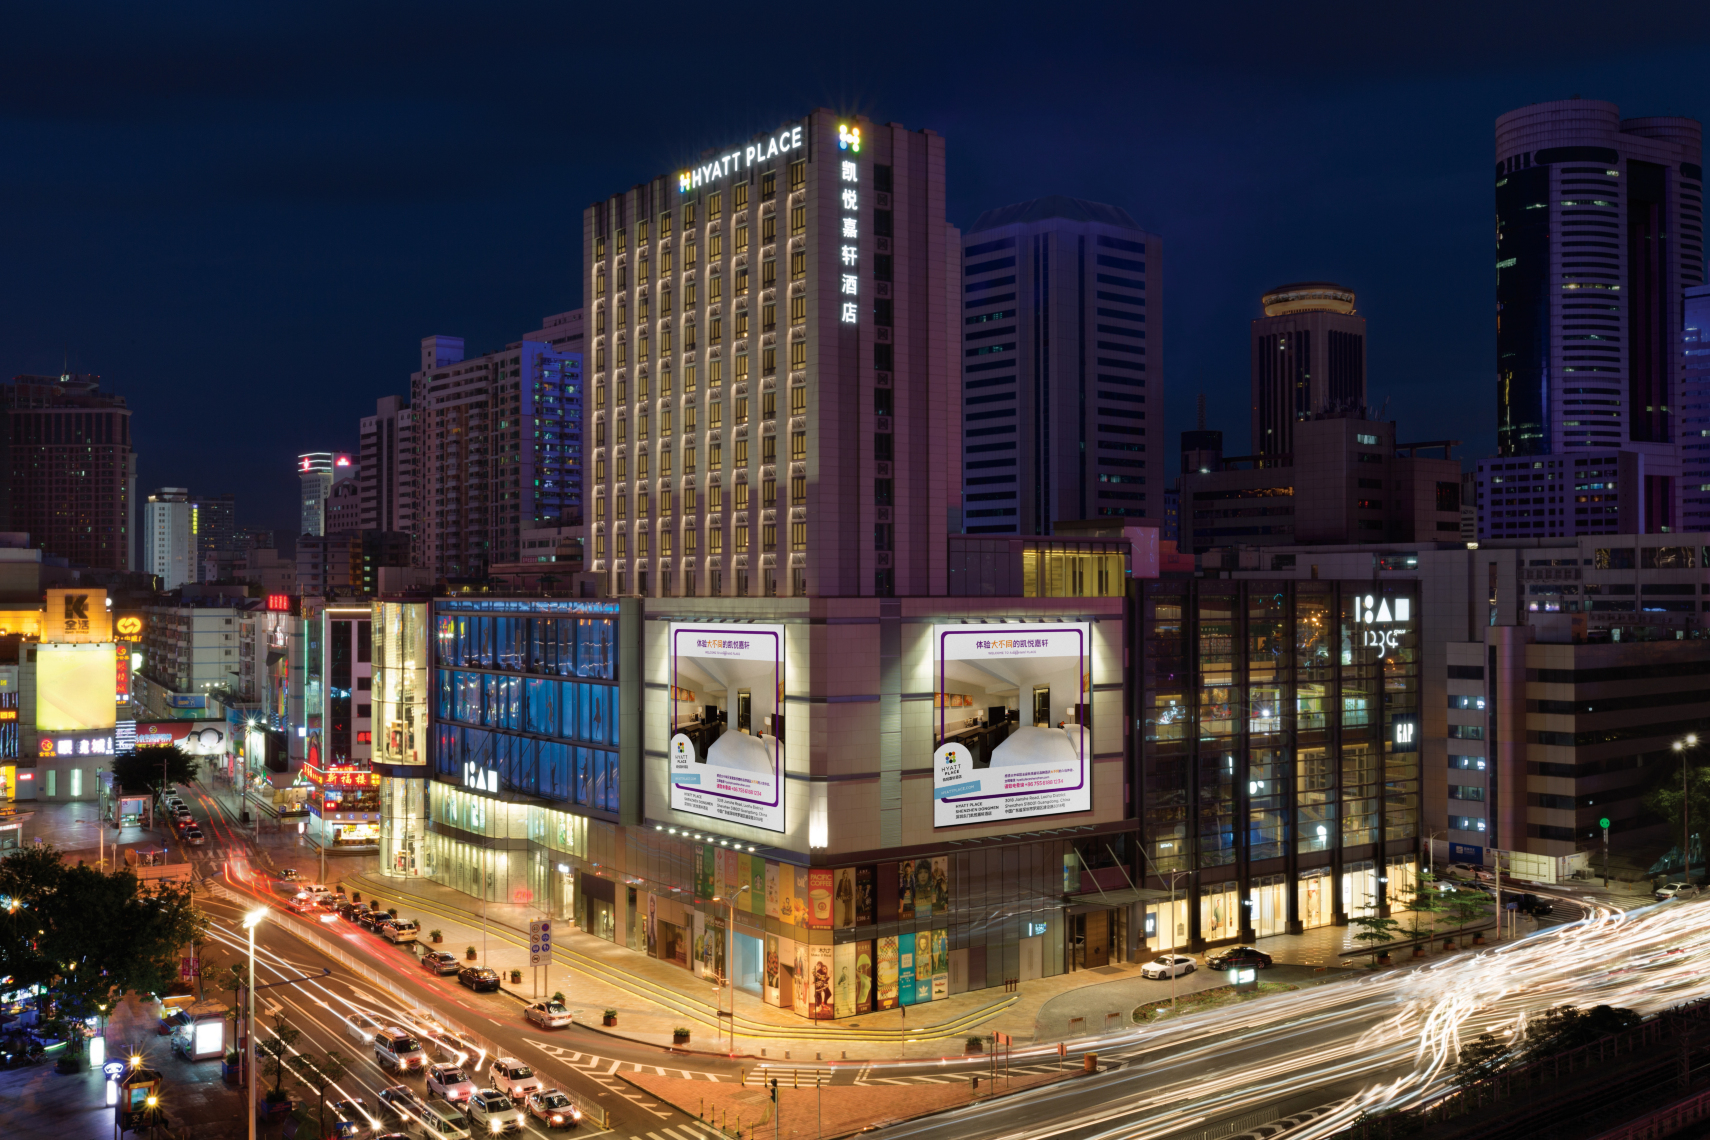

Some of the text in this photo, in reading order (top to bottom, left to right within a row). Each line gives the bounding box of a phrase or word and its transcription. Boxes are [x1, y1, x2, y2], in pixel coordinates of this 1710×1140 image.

[692, 126, 803, 190] HYATT PLACE
[840, 160, 858, 324] 凯悦嘉轩酒店
[976, 639, 1049, 649] 体验大不同的凯悦嘉轩
[1396, 723, 1414, 744] GAP
[941, 764, 961, 772] HYATT
